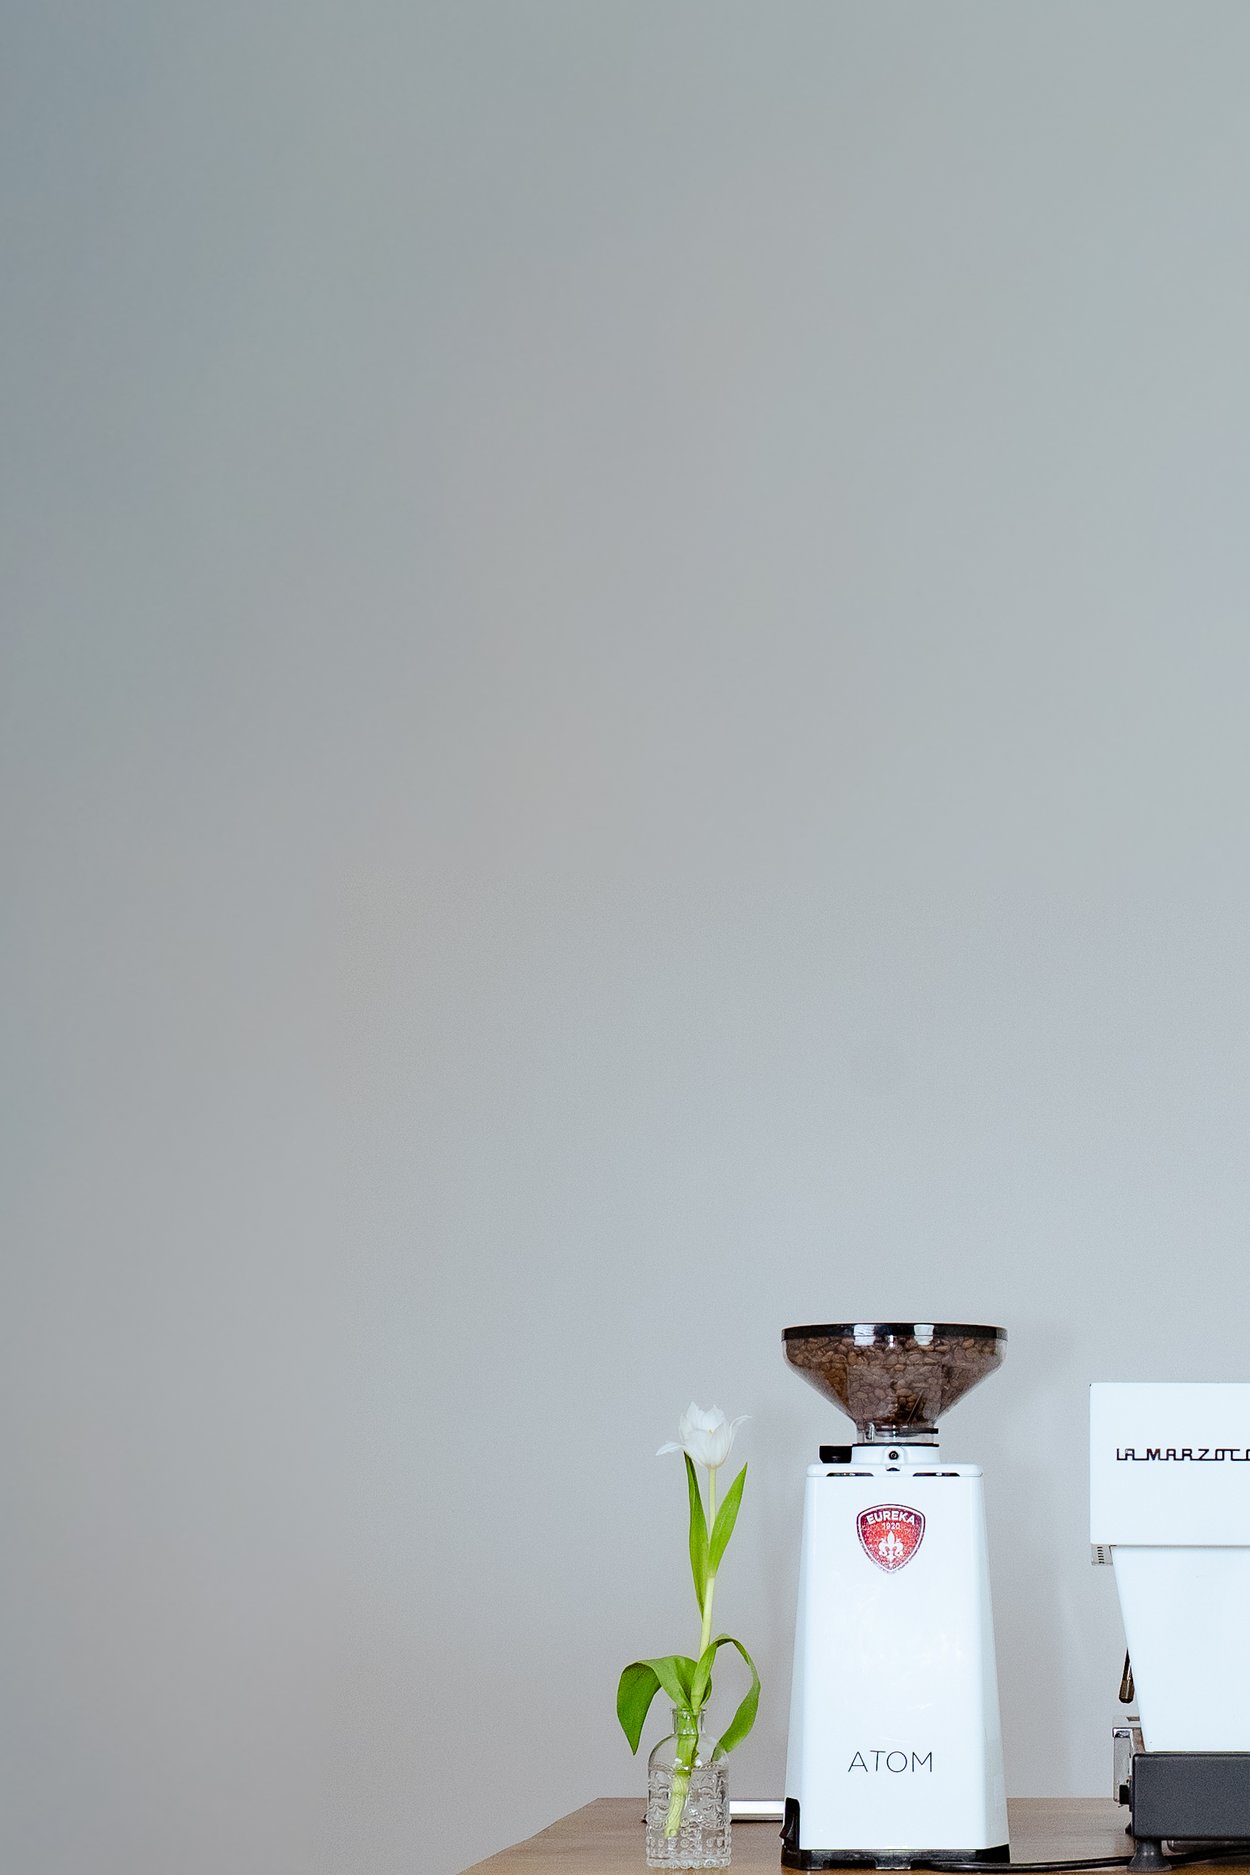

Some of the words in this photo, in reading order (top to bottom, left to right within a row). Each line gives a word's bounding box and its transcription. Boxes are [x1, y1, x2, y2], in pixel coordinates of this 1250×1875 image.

[865, 1510, 916, 1525] EUREKA
[881, 1522, 900, 1530] 1920
[847, 1749, 934, 1774] ATOM
